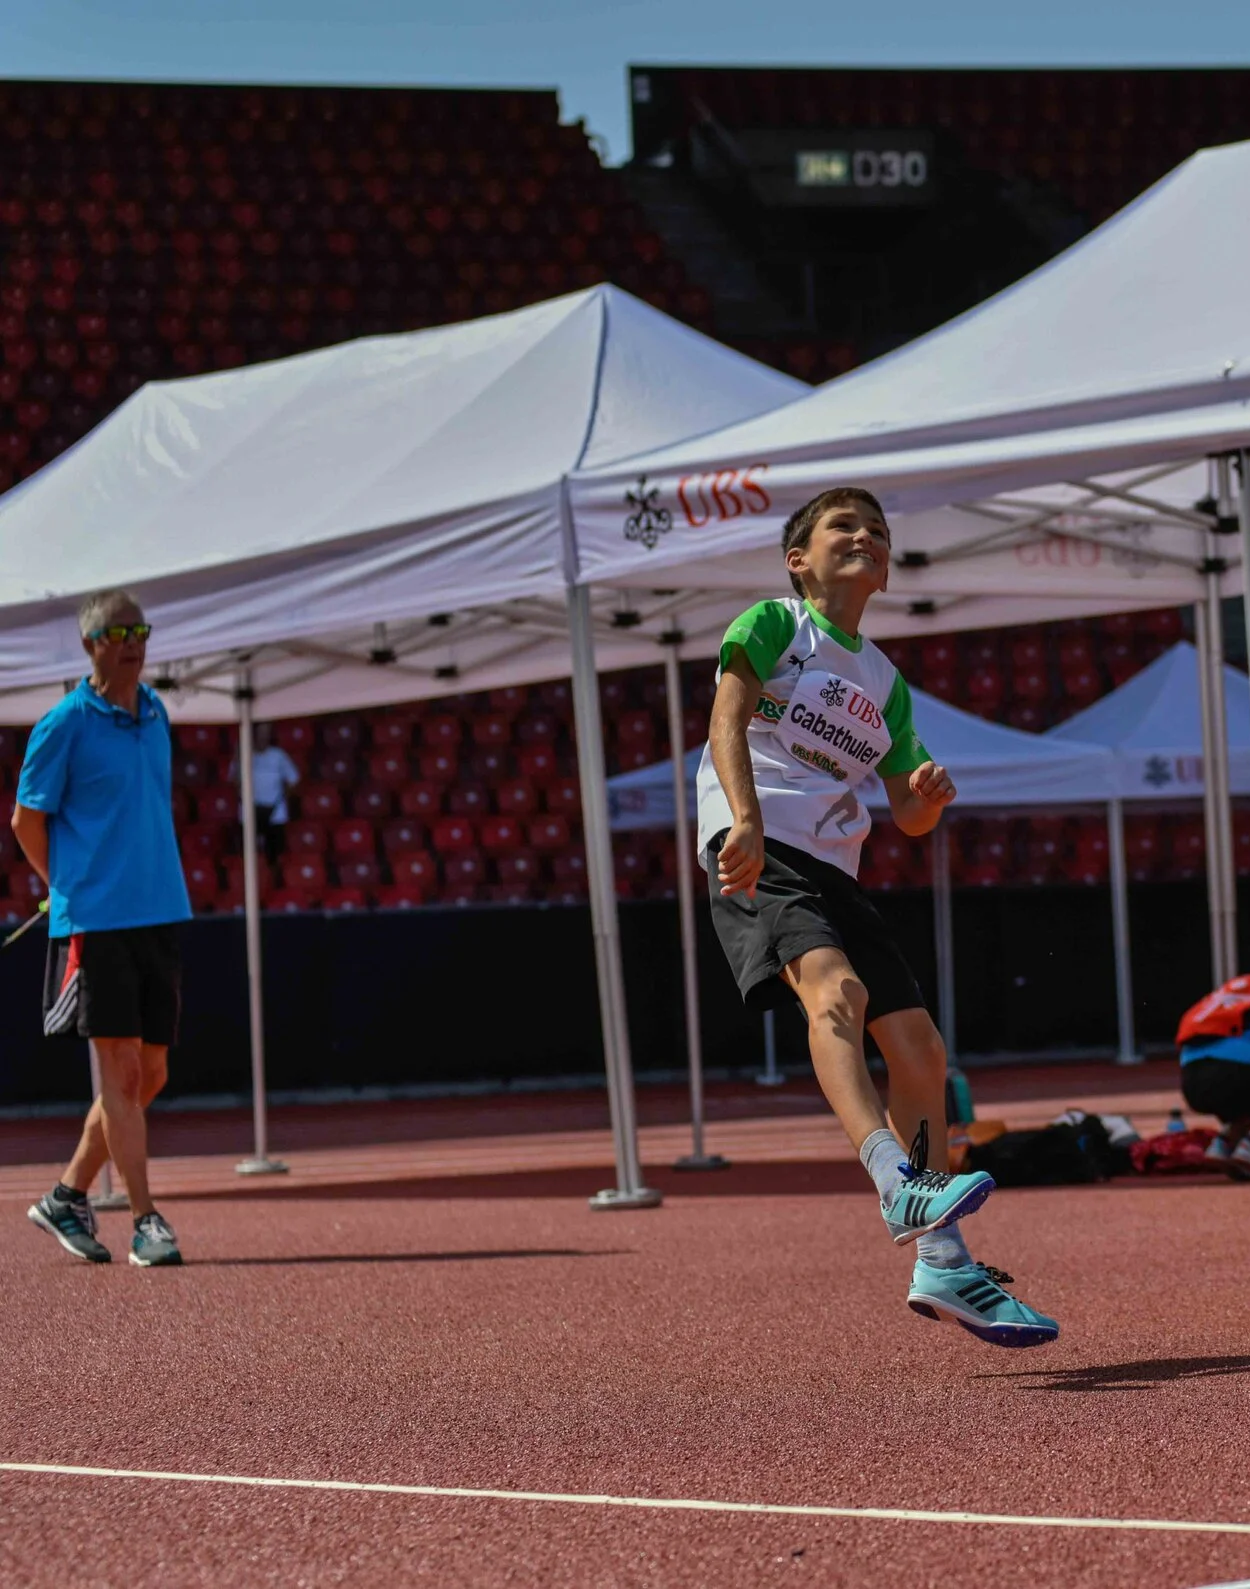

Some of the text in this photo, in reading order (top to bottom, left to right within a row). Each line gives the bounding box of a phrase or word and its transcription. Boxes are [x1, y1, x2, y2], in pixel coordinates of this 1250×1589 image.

[853, 151, 927, 186] D30
[677, 463, 772, 527] UBS
[790, 702, 880, 765] Gabathuler
[847, 691, 883, 730] UBS
